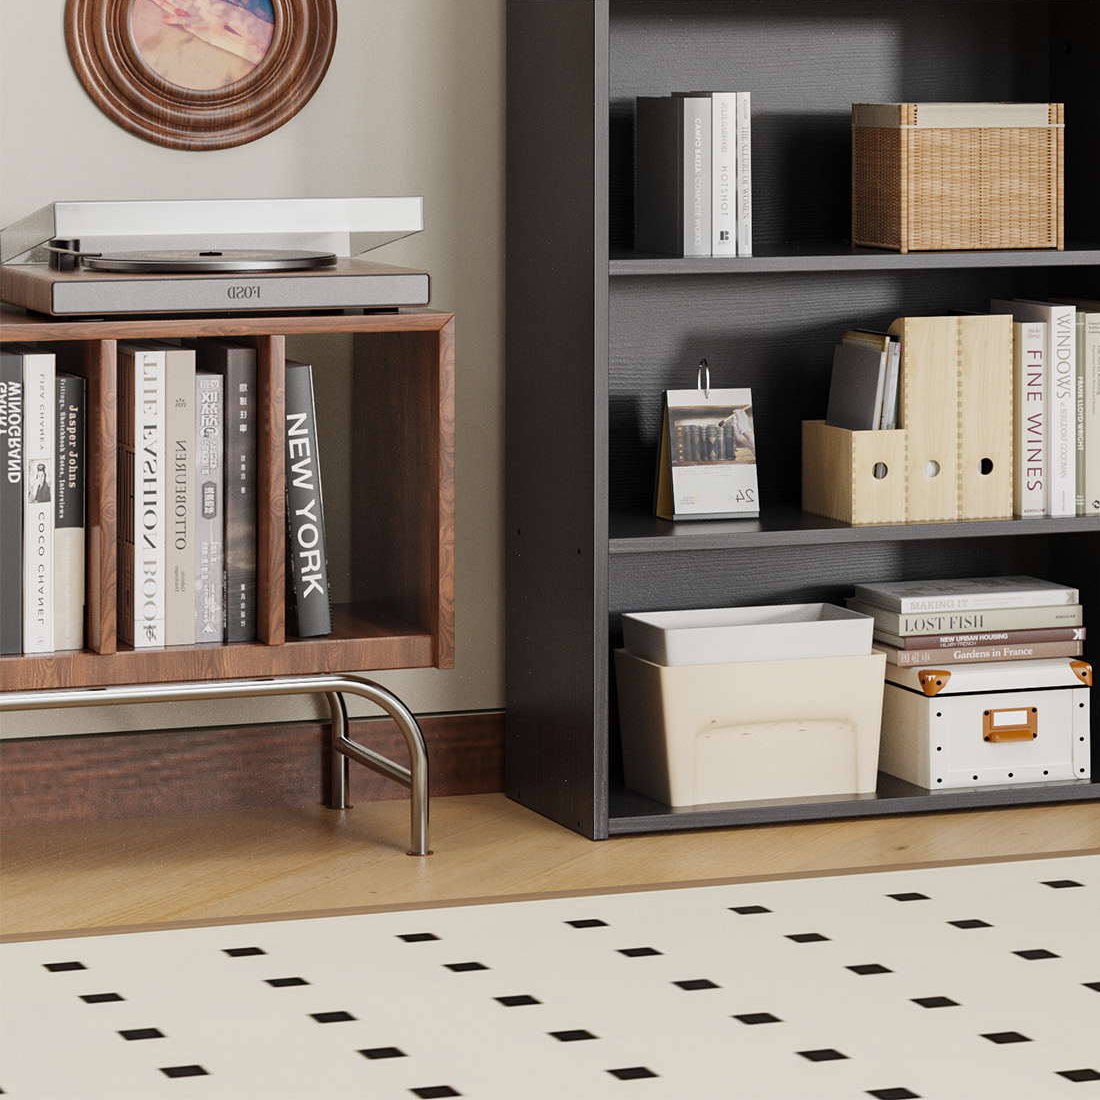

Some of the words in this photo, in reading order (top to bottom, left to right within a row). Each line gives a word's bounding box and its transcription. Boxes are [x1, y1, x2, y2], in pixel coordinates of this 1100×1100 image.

[721, 165, 729, 216] HOTSHOT
[742, 187, 750, 219] WOMEN
[1027, 350, 1042, 402] FINE
[1056, 313, 1072, 399] WINDOWS
[66, 405, 78, 448] Jasper
[69, 450, 78, 489] Johns
[286, 413, 314, 490] NEW
[1027, 413, 1042, 491] WINES
[295, 498, 324, 598] YORK
[905, 616, 946, 632] LOST
[950, 615, 983, 630] FISH
[910, 600, 954, 611] MAKING
[957, 599, 968, 608] IT
[953, 650, 990, 660] Gardens
[992, 649, 1001, 657] in
[1003, 647, 1033, 656] France
[979, 633, 1008, 641] HOUSING
